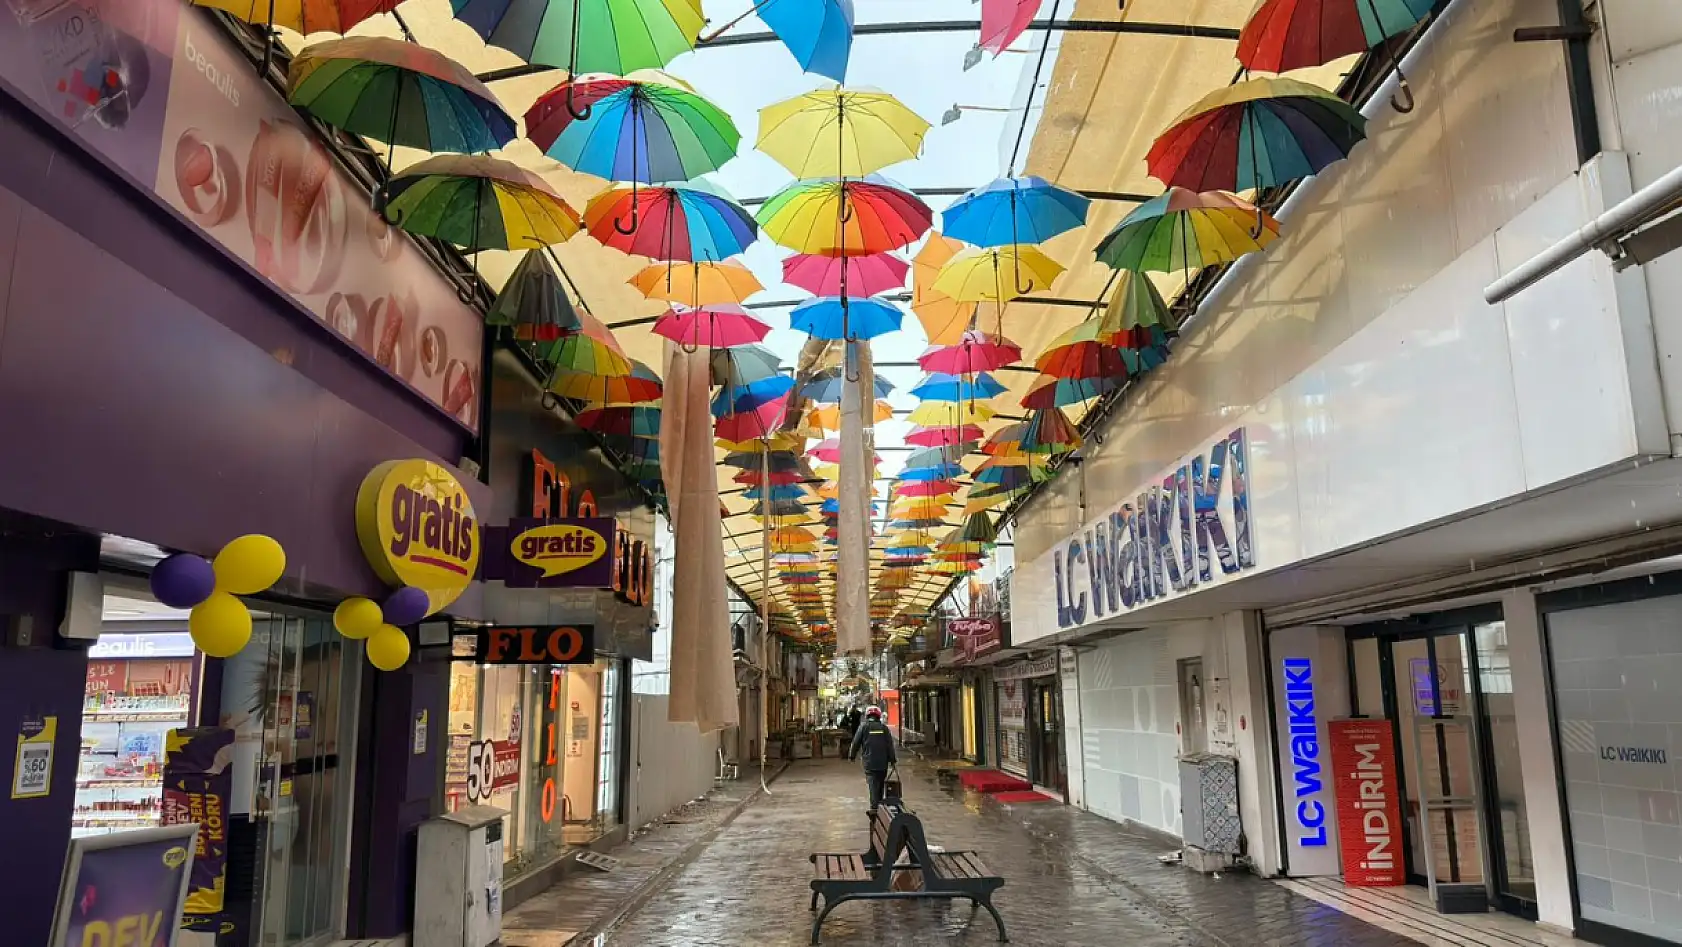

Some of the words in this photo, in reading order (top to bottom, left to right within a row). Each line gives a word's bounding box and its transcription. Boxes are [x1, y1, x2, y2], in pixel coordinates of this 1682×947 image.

[185, 30, 241, 107] beaulis
[391, 484, 473, 562] gratis
[520, 529, 596, 560] gratis
[1054, 538, 1088, 628] LC
[96, 637, 155, 655] eaulis
[486, 627, 583, 660] FLO
[467, 739, 495, 802] 50
[1600, 746, 1616, 761] LC
[205, 794, 222, 840] KORU
[1297, 800, 1327, 846] LC
[1351, 743, 1394, 869] İNDİRİM
